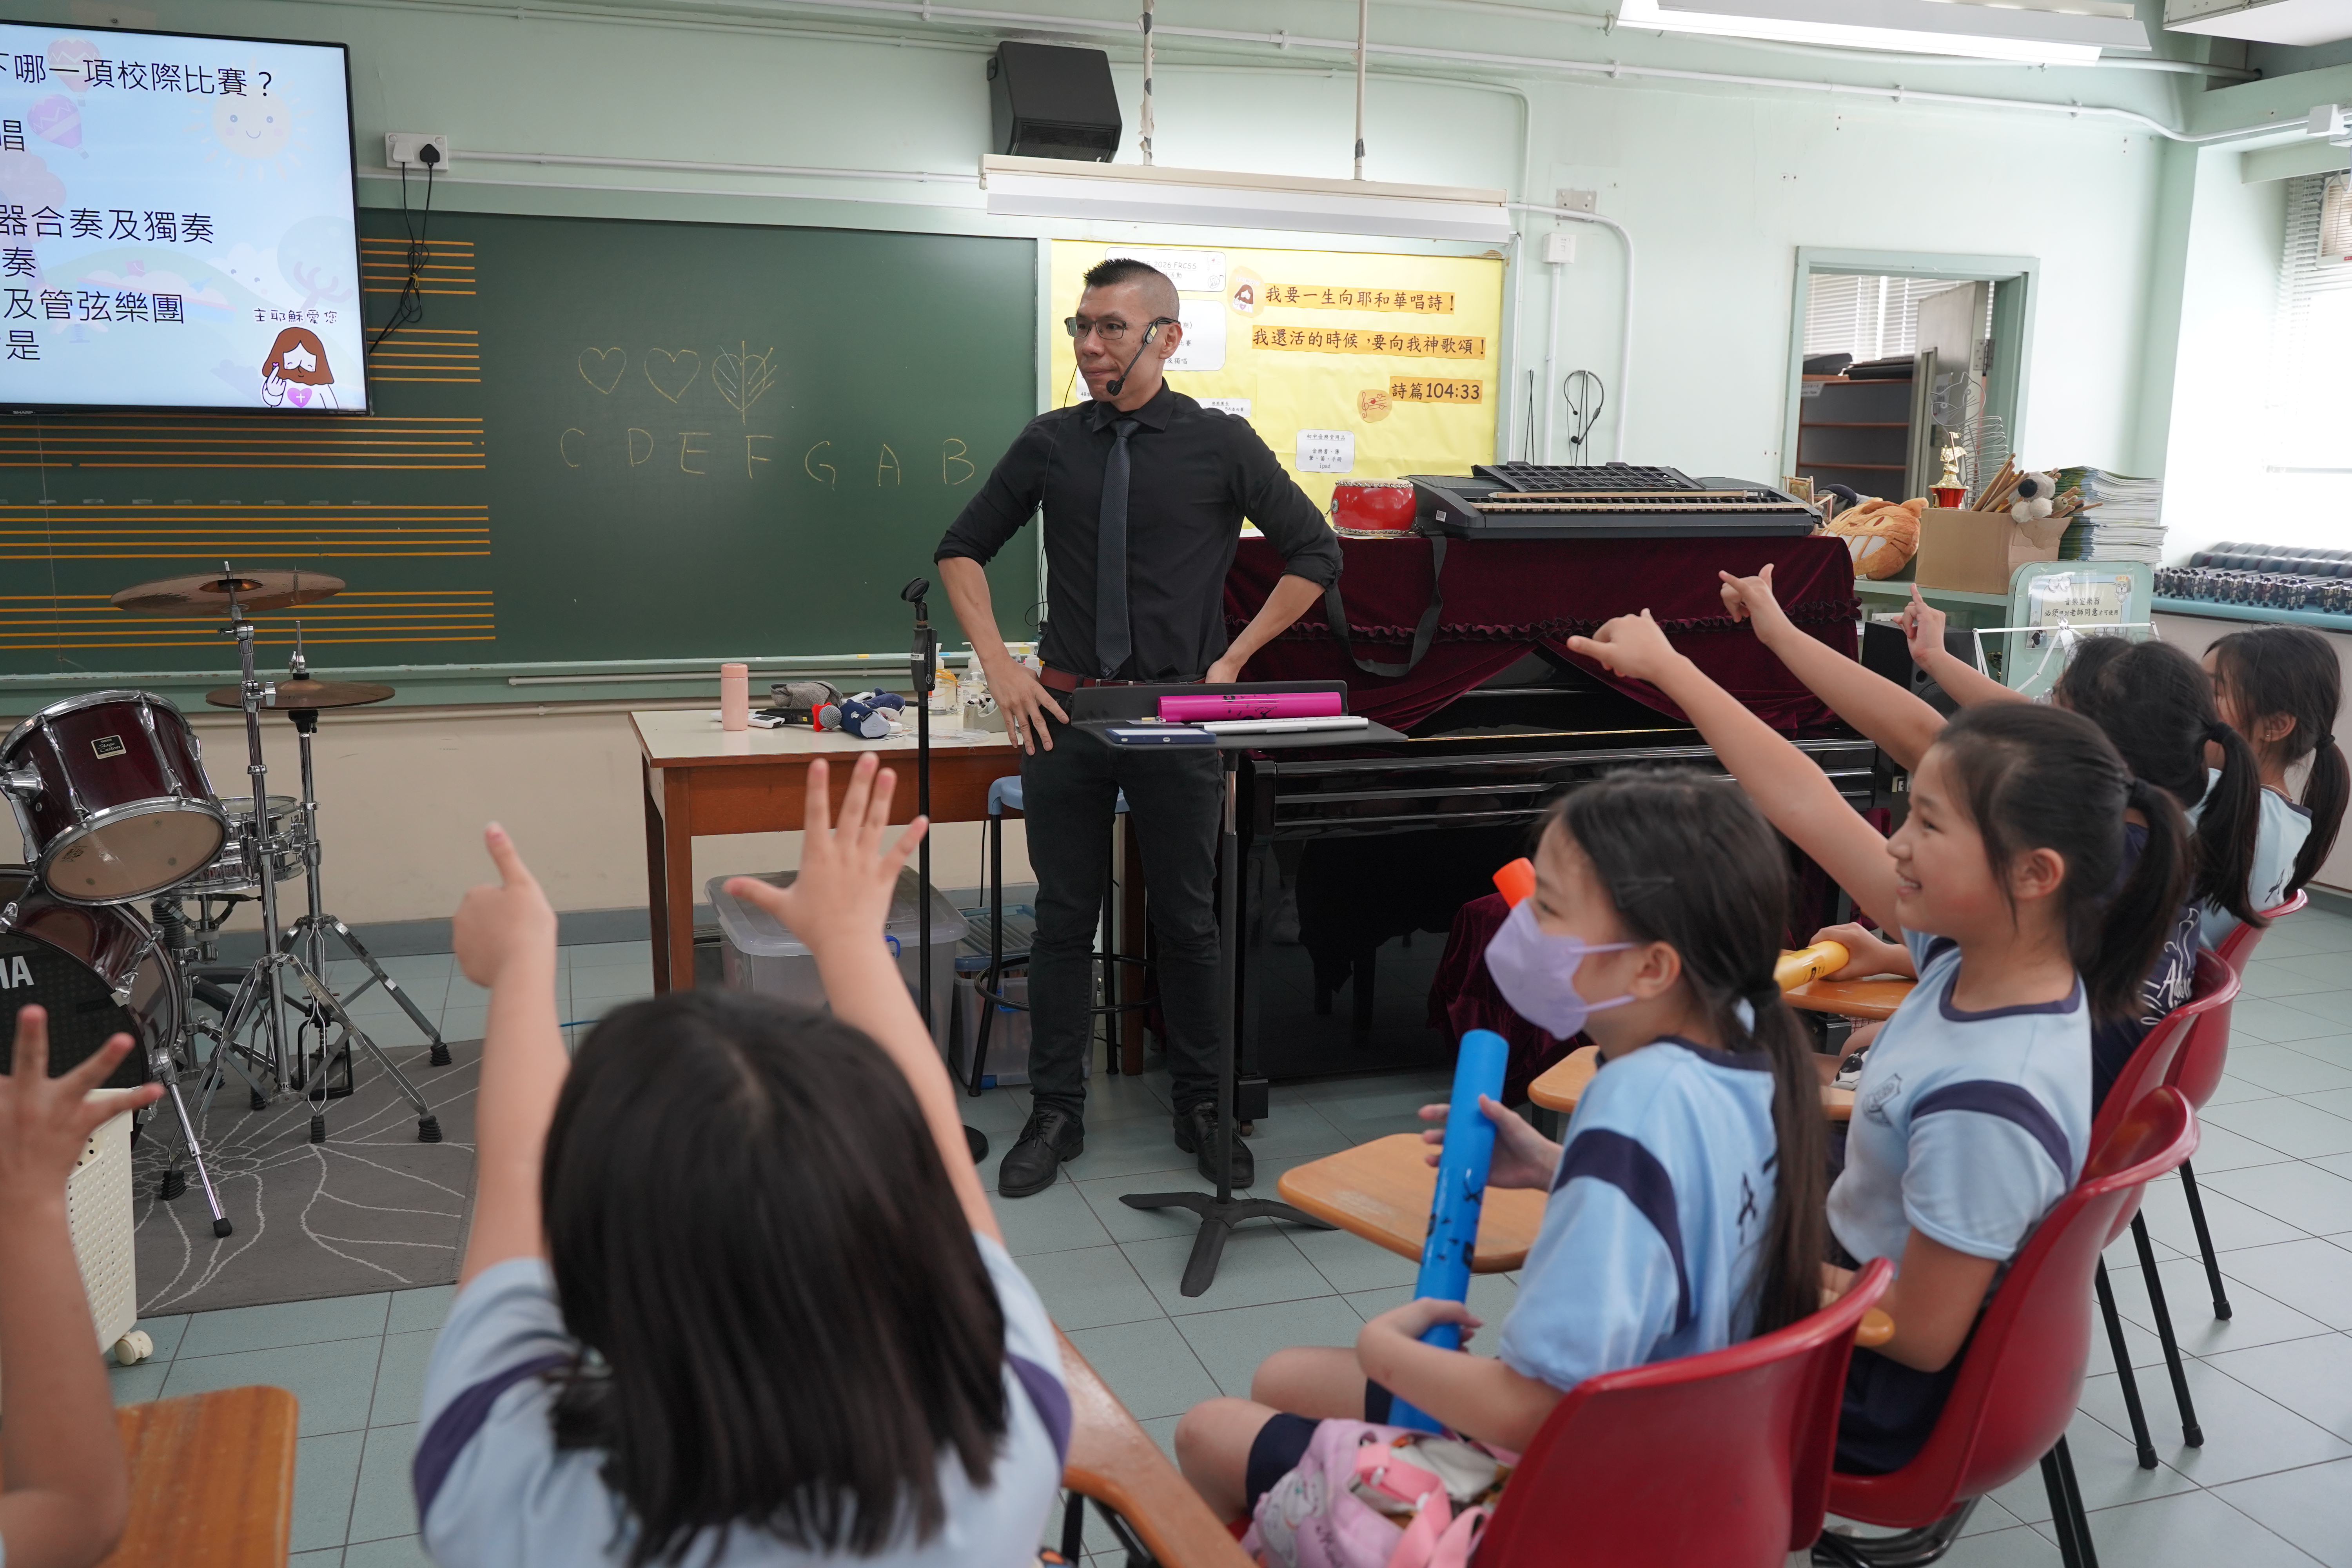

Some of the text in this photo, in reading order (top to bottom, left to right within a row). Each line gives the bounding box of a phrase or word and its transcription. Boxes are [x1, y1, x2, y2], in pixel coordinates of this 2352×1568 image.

[0, 53, 272, 96] 哪一項校際比賽？
[0, 205, 214, 244] 器合奏及獨奏
[2, 247, 36, 278] 奏
[4, 289, 184, 324] 及管弦樂團
[1265, 285, 1454, 311] 我要一生向耶和華唱詩！
[254, 308, 337, 325] 主耶穌愛您
[5, 330, 40, 361] 是
[1252, 328, 1485, 354] 我還活的時候，要向我神歌頌！
[1391, 382, 1479, 400] 詩篇104:33
[560, 427, 975, 491] C D E F G A B
[2064, 597, 2100, 606] 音樂室樂器
